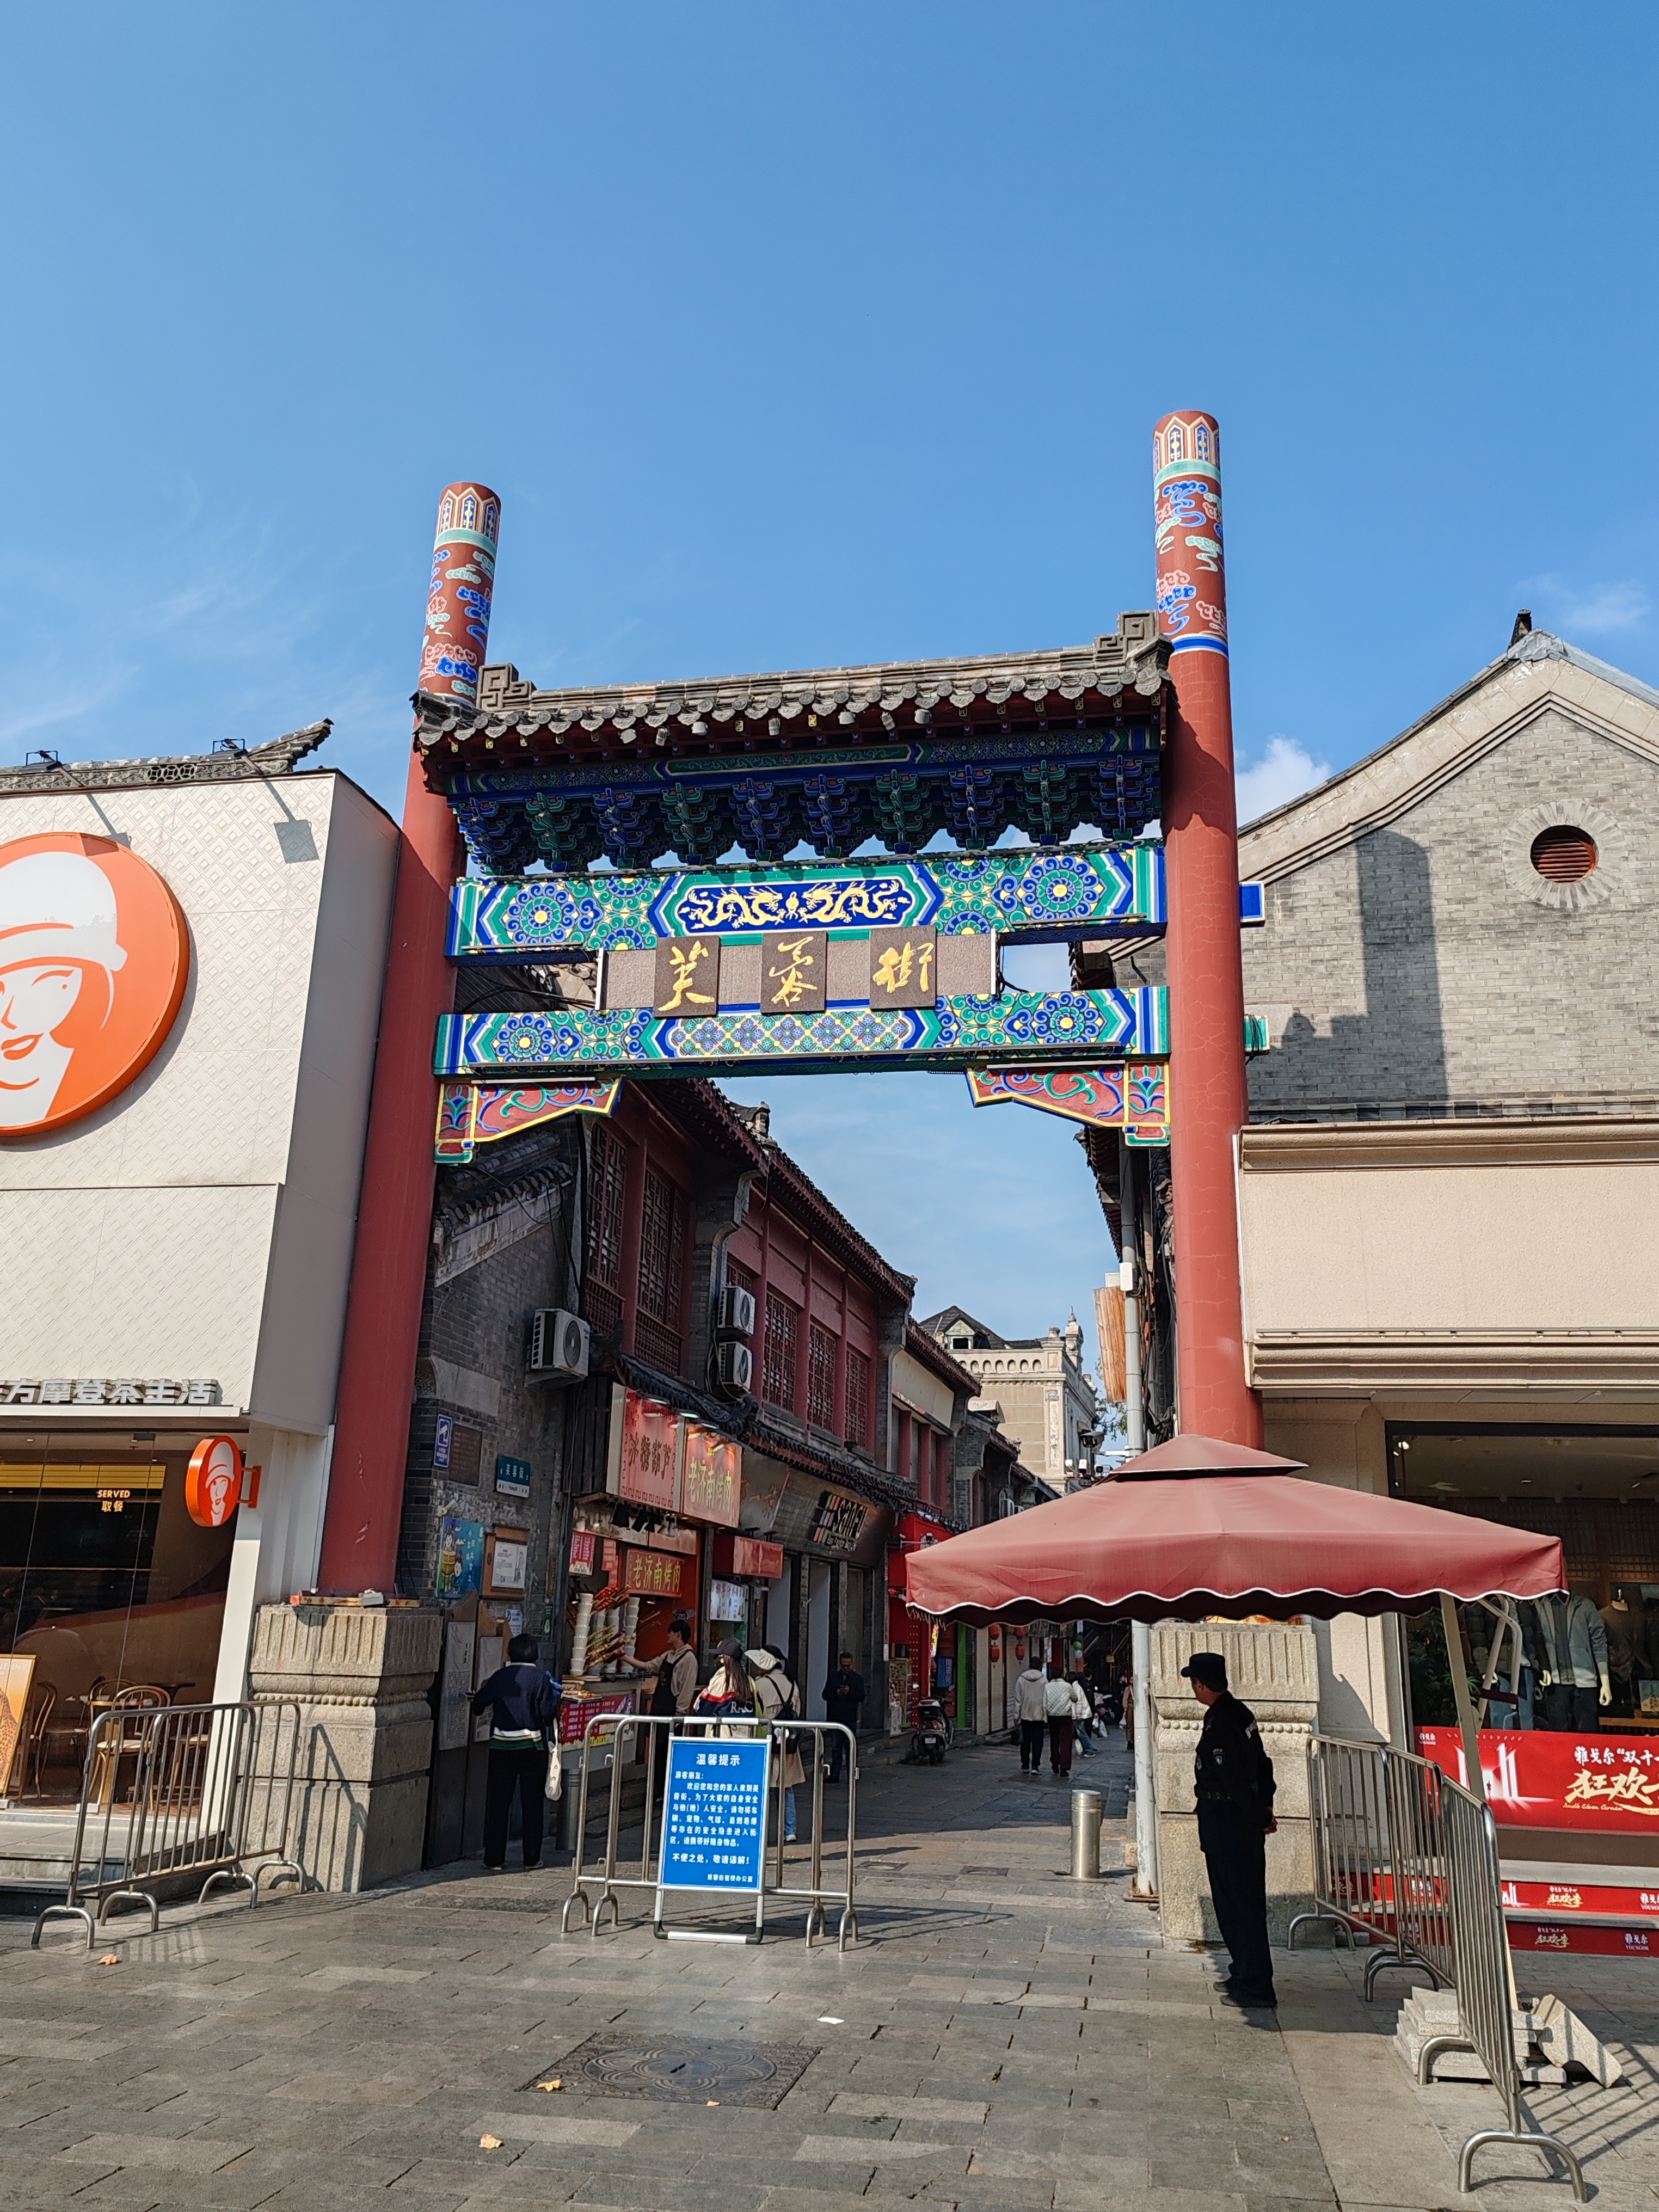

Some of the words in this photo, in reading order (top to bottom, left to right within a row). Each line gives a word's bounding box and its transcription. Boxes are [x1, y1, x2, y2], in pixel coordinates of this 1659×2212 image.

[658, 936, 934, 1012] 芙蓉街
[687, 1455, 732, 1513] 老济南烤肉
[97, 1490, 131, 1498] SERVED
[101, 1501, 124, 1512] 取餐
[632, 1553, 681, 1593] 老济南烤肉
[696, 1753, 740, 1766] 温馨提示
[1625, 1933, 1649, 1945] 雅戈尔
